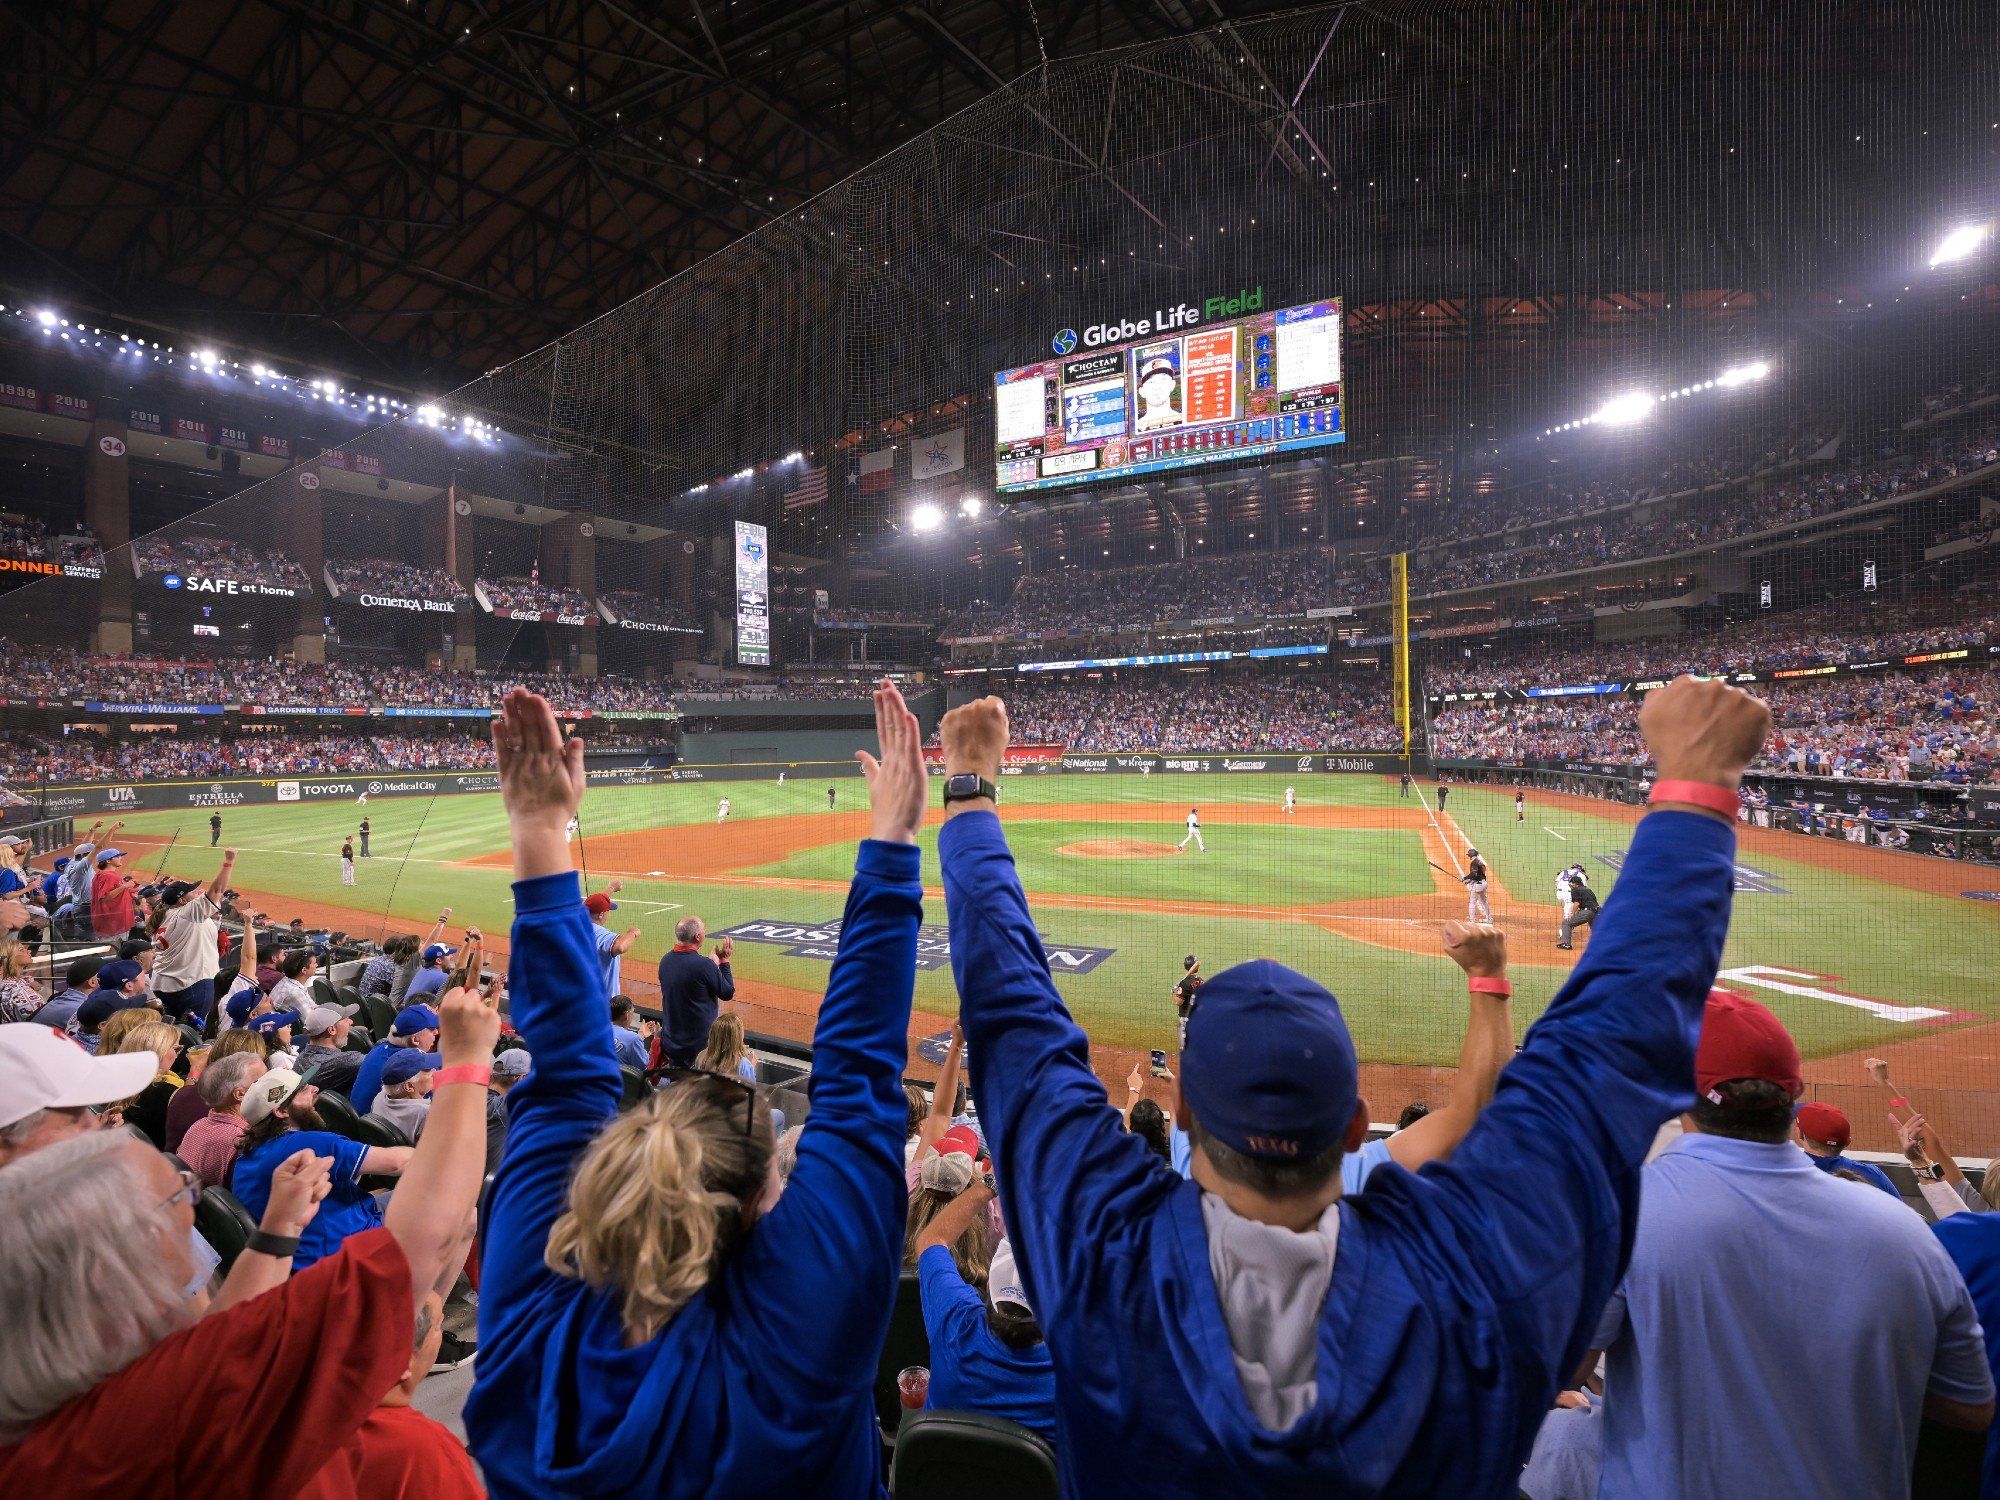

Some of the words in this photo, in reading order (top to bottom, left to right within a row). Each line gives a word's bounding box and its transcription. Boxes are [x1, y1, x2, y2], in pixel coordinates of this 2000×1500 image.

[1084, 318, 1150, 346] Globe
[1156, 304, 1199, 331] Life
[1206, 286, 1262, 319] Field
[1073, 356, 1118, 372] CHOCTAW
[103, 440, 123, 453] 34
[1206, 453, 1232, 462] MULLINS
[302, 475, 317, 487] 26
[461, 503, 467, 512] 7
[64, 565, 101, 573] STAFFING
[66, 571, 100, 579] SERVICES
[186, 577, 238, 594] SAFE
[242, 584, 256, 593] at
[260, 585, 295, 596] home
[424, 600, 455, 612] Bank
[625, 620, 669, 632] CHOCTAW
[1191, 617, 1234, 626] POWERADE
[1073, 760, 1108, 768] National
[1129, 756, 1156, 768] Kroger
[1338, 758, 1374, 771] Mobile
[303, 784, 354, 795] TOYOTA
[385, 782, 418, 791] Medical
[420, 782, 436, 790] City
[109, 787, 136, 801] UTA
